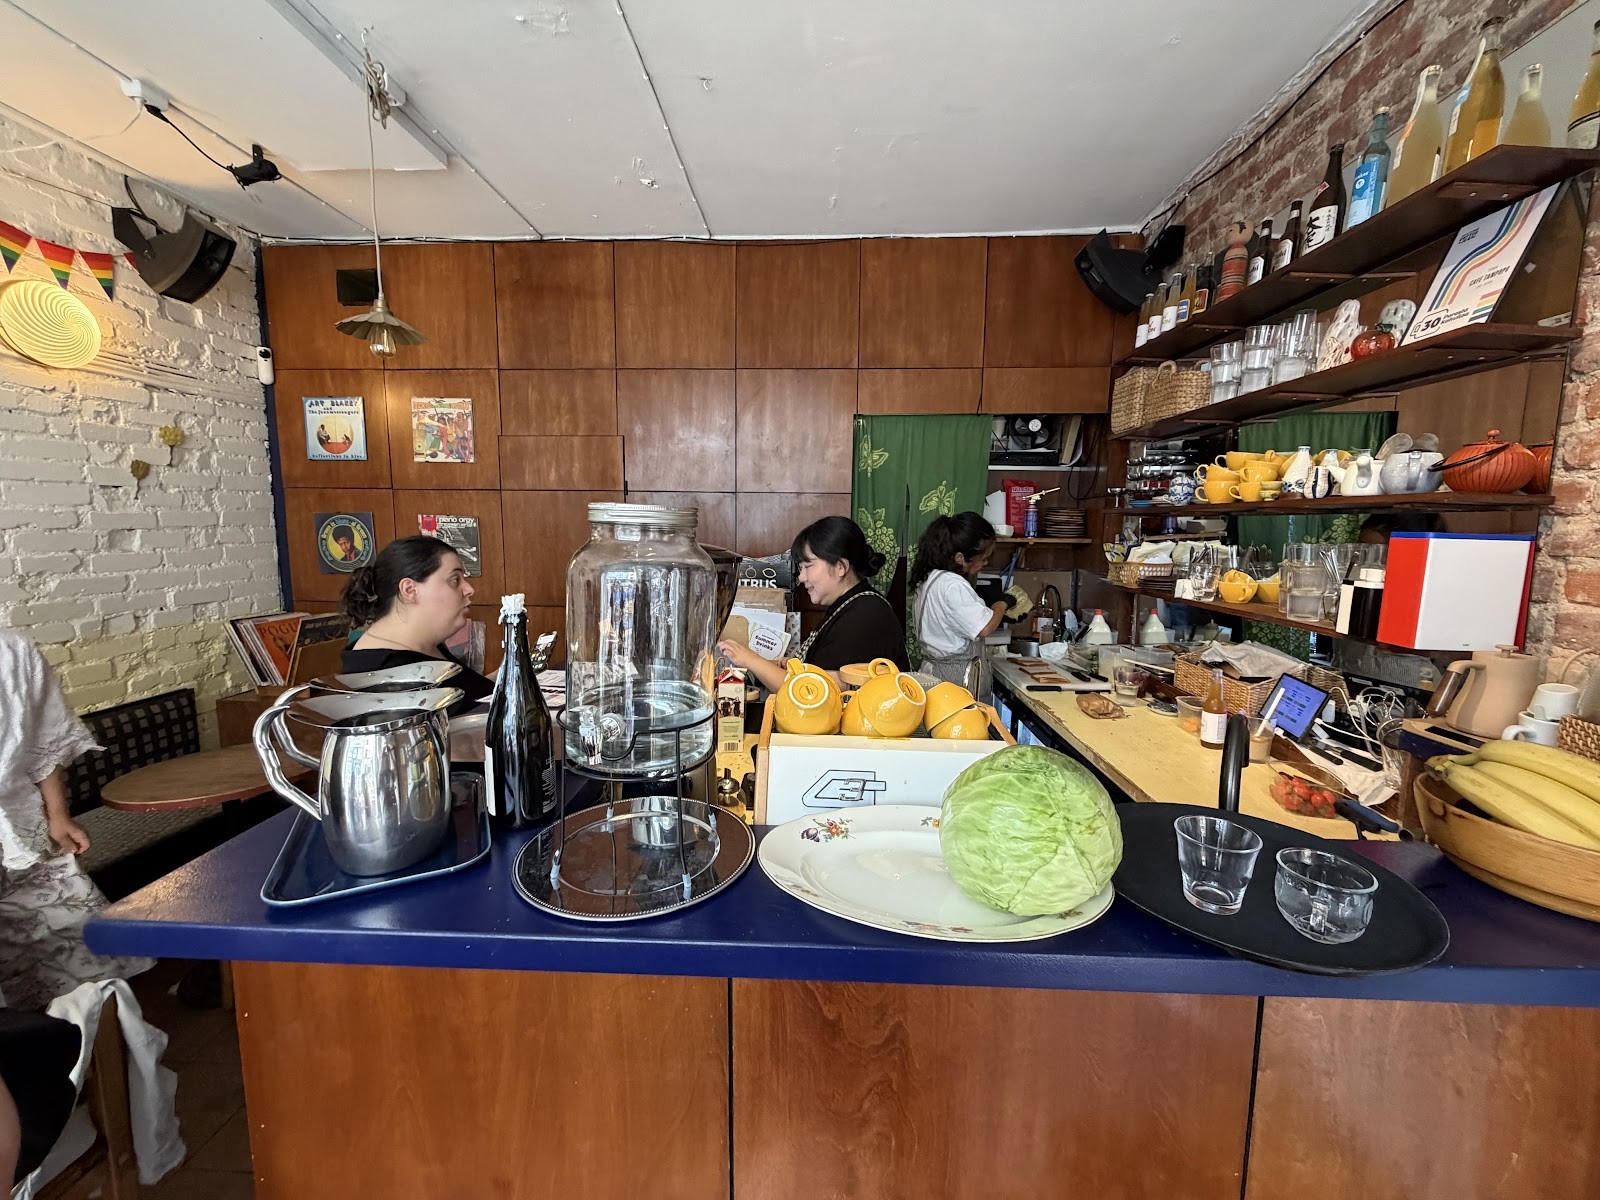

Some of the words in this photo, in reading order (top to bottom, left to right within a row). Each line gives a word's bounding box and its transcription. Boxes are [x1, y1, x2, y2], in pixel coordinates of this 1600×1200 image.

[1420, 317, 1442, 332] 30
[308, 400, 325, 408] ART
[458, 517, 475, 525] orgy
[755, 634, 778, 647] Summer
[755, 640, 774, 651] Drinks
